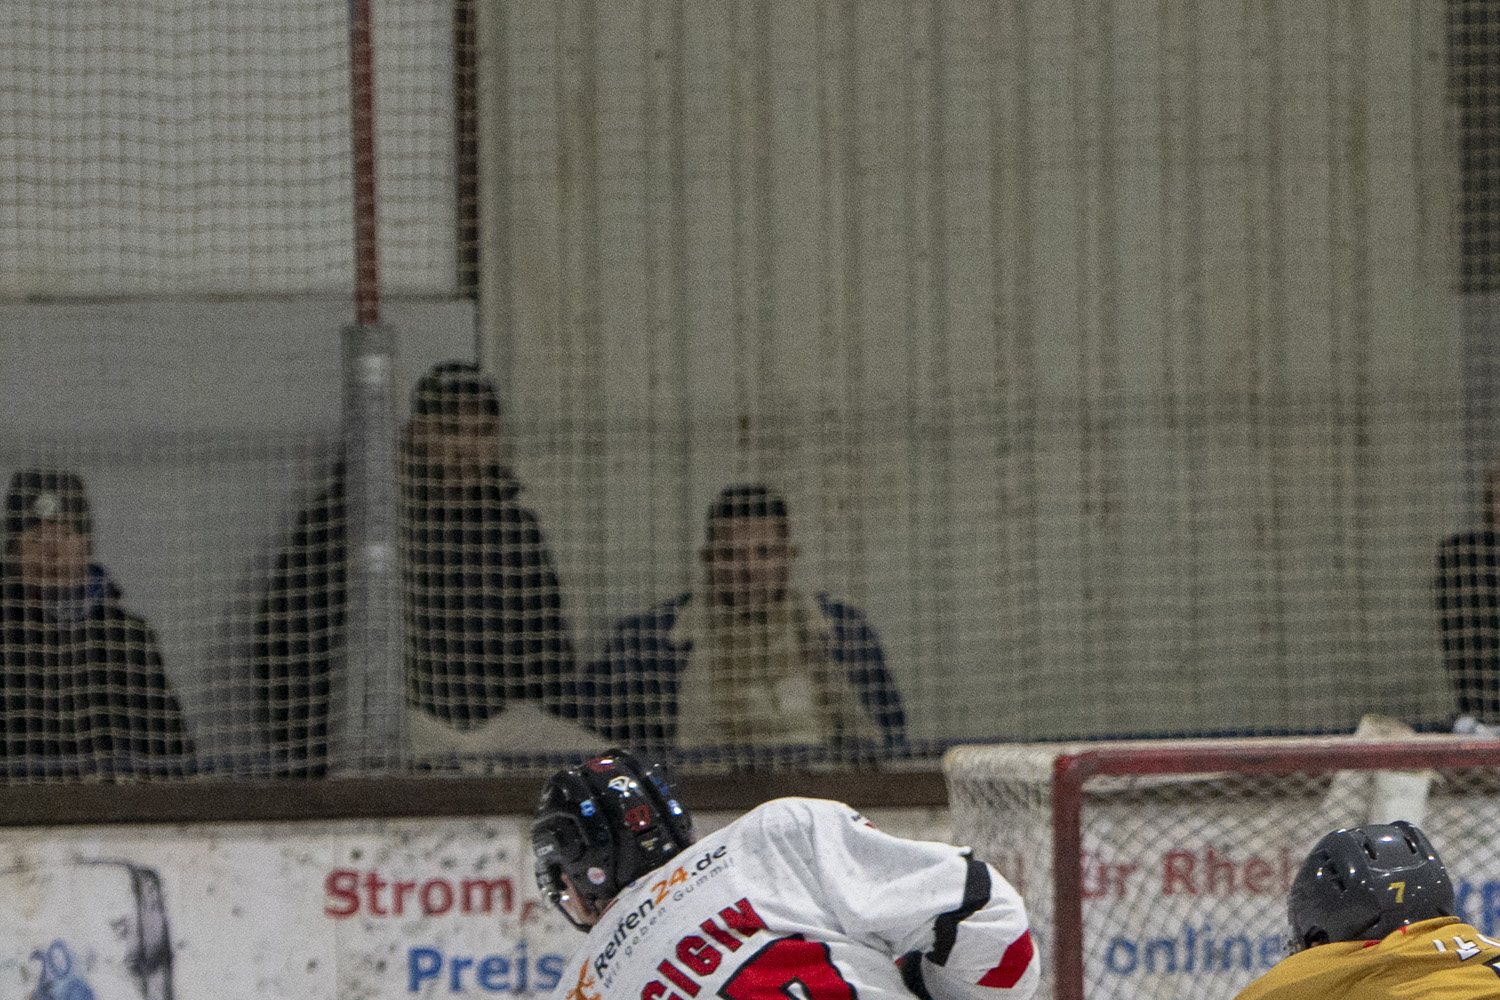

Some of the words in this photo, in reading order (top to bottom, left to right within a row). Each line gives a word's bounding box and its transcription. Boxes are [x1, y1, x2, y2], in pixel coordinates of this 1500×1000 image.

[1162, 844, 1292, 897] Rhei
[1387, 881, 1406, 903] 7
[594, 845, 728, 979] Reifen24.de
